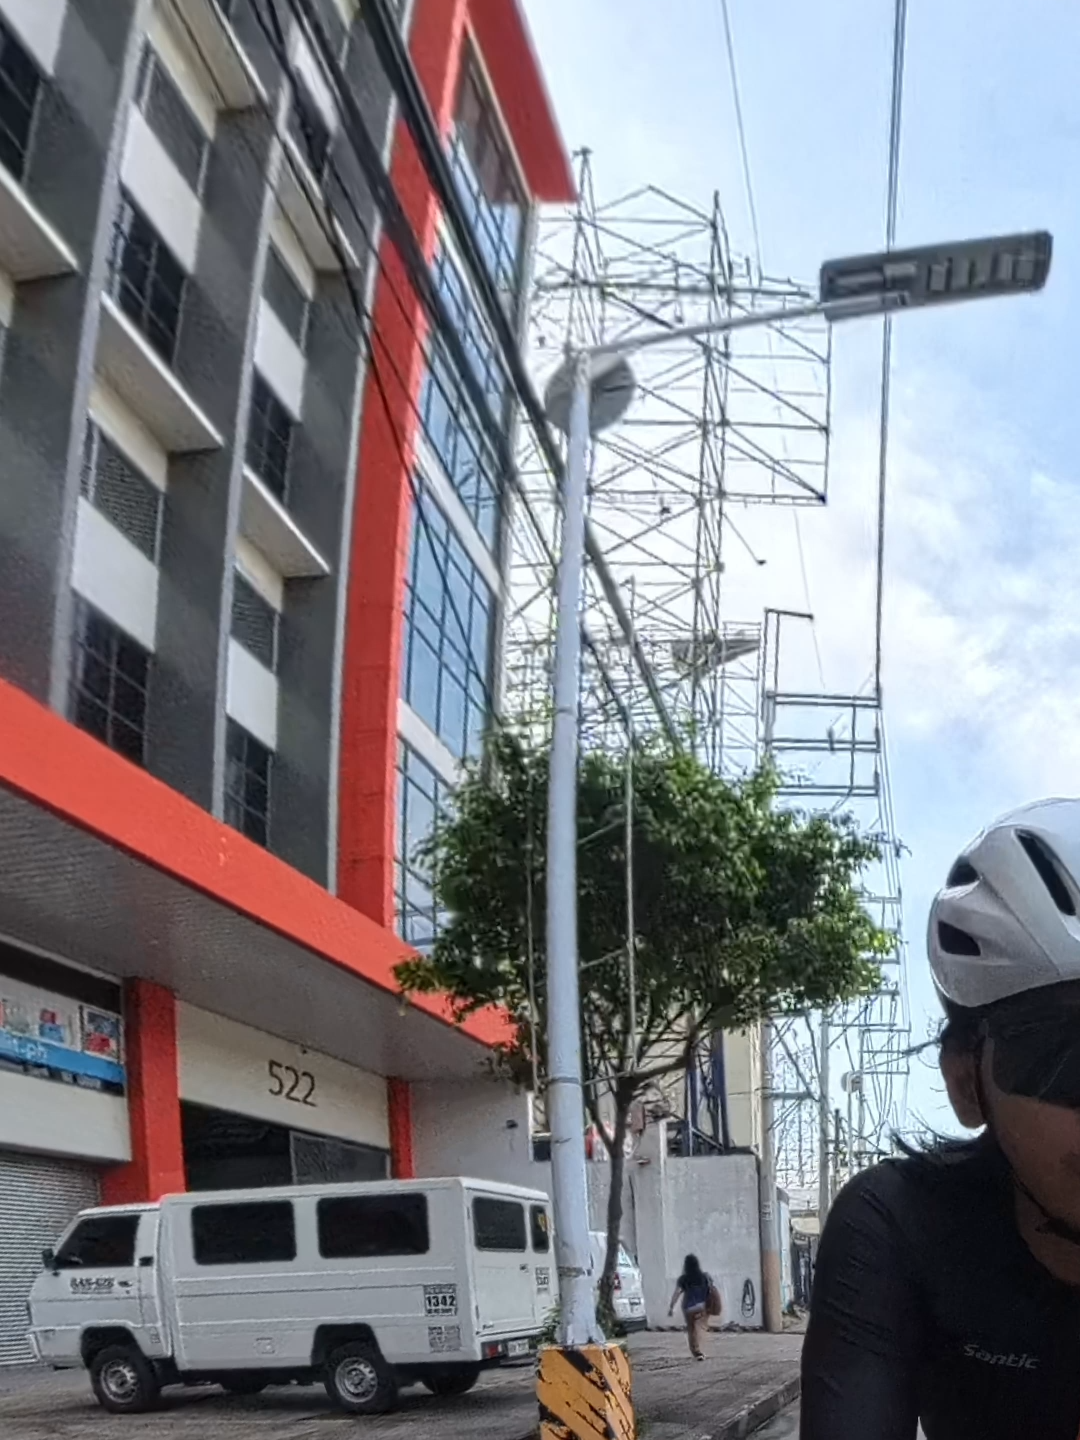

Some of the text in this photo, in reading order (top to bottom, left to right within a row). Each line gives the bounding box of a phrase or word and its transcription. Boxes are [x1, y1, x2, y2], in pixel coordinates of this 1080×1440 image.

[268, 1059, 317, 1107] 522
[426, 1295, 456, 1307] 1342
[963, 1343, 1040, 1369] Santic
